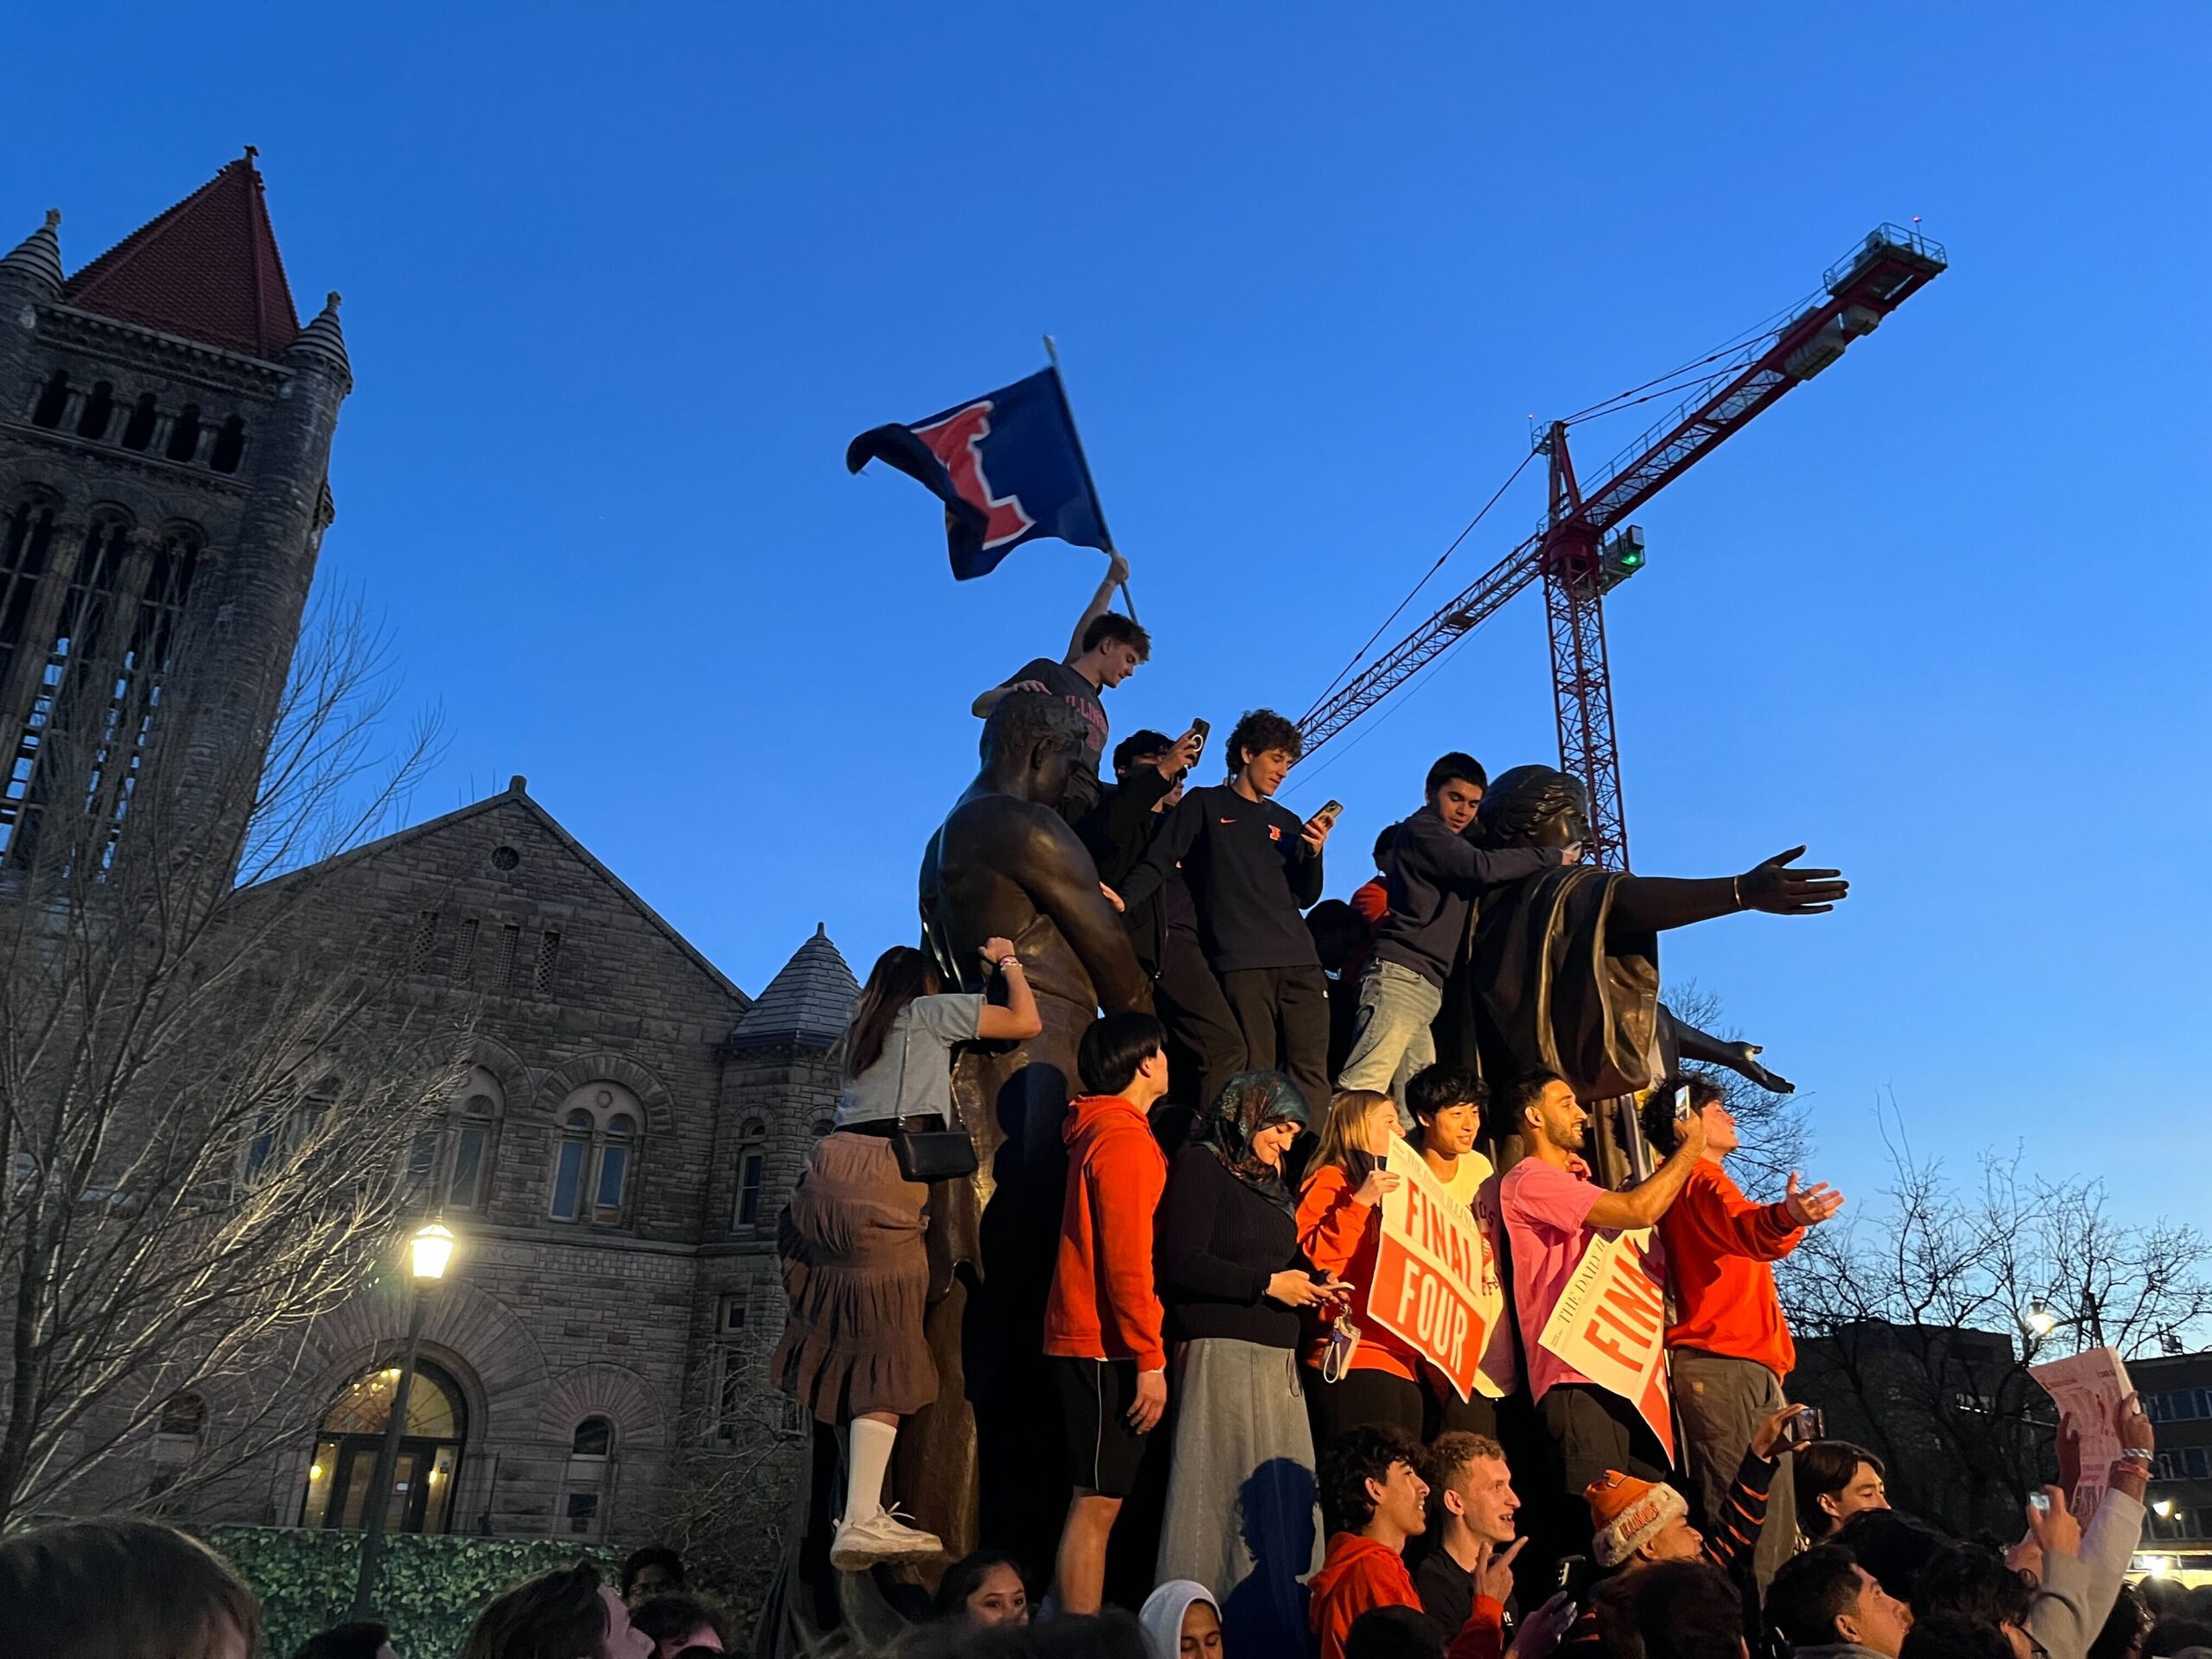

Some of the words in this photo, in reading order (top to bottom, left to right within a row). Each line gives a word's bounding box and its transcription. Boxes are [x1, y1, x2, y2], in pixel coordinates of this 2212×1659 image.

[1405, 1176, 1477, 1296] FINAL
[1558, 1291, 1582, 1323] THE
[1574, 1249, 1601, 1293] DAILY
[1396, 1257, 1467, 1376] FOUR
